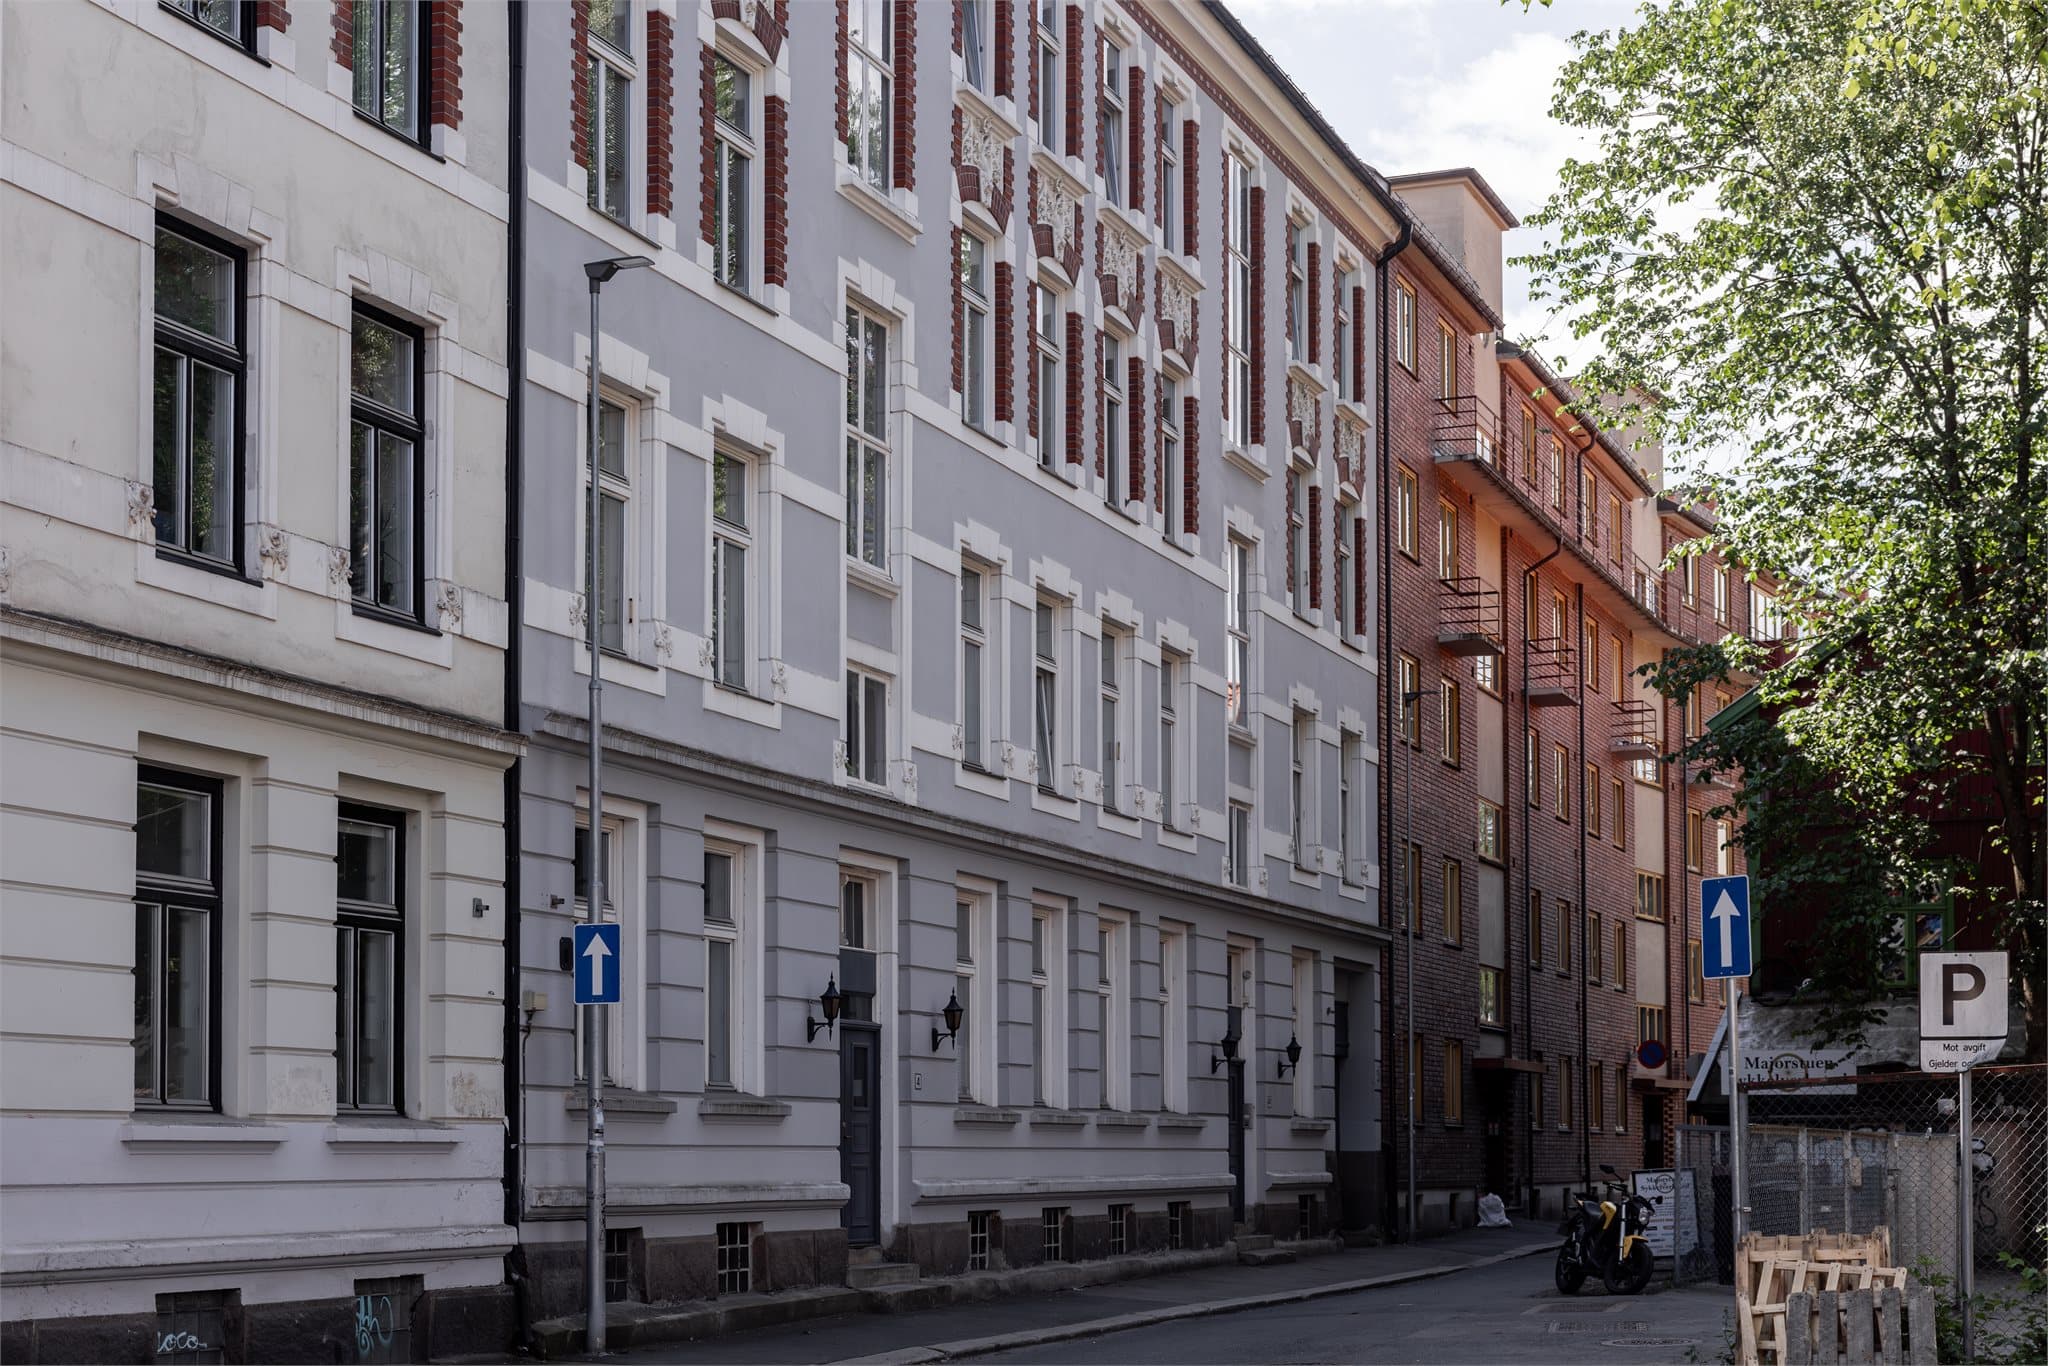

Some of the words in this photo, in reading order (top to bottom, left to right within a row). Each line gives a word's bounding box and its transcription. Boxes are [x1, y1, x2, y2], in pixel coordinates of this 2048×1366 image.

[1942, 963, 1986, 1026] P
[1943, 1043, 1959, 1052] Mot
[1963, 1043, 1986, 1054] avgift
[1929, 1059, 1957, 1070] Gjelder
